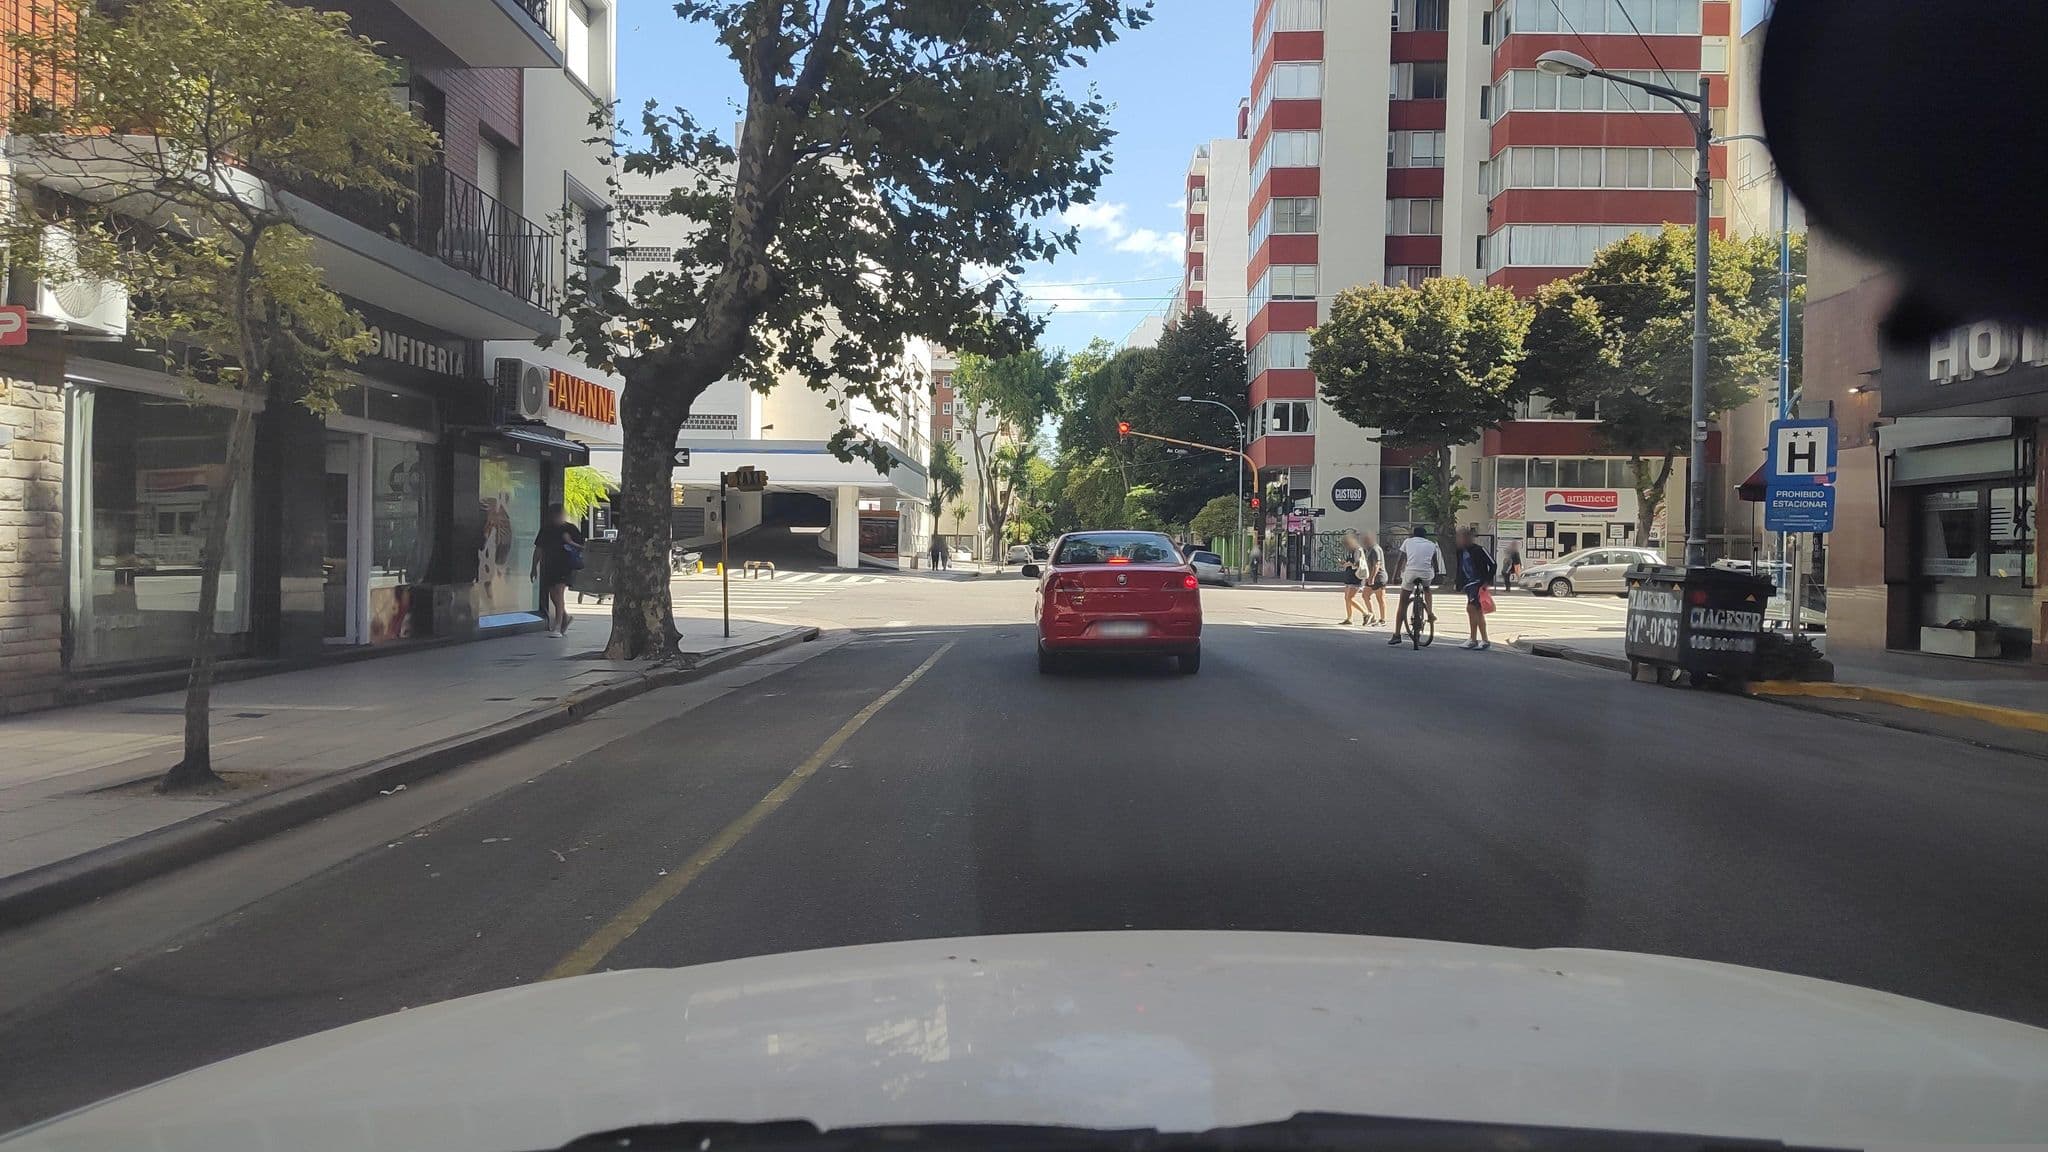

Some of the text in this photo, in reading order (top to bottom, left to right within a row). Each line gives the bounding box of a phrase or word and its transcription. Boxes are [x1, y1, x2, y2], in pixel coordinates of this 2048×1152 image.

[548, 367, 617, 425] HAVANNA
[1335, 488, 1362, 498] GUSTOSO
[1776, 490, 1825, 499] PROHIBIDO
[1567, 494, 1616, 503] amanecer
[1773, 500, 1828, 508] ESTACIONAR
